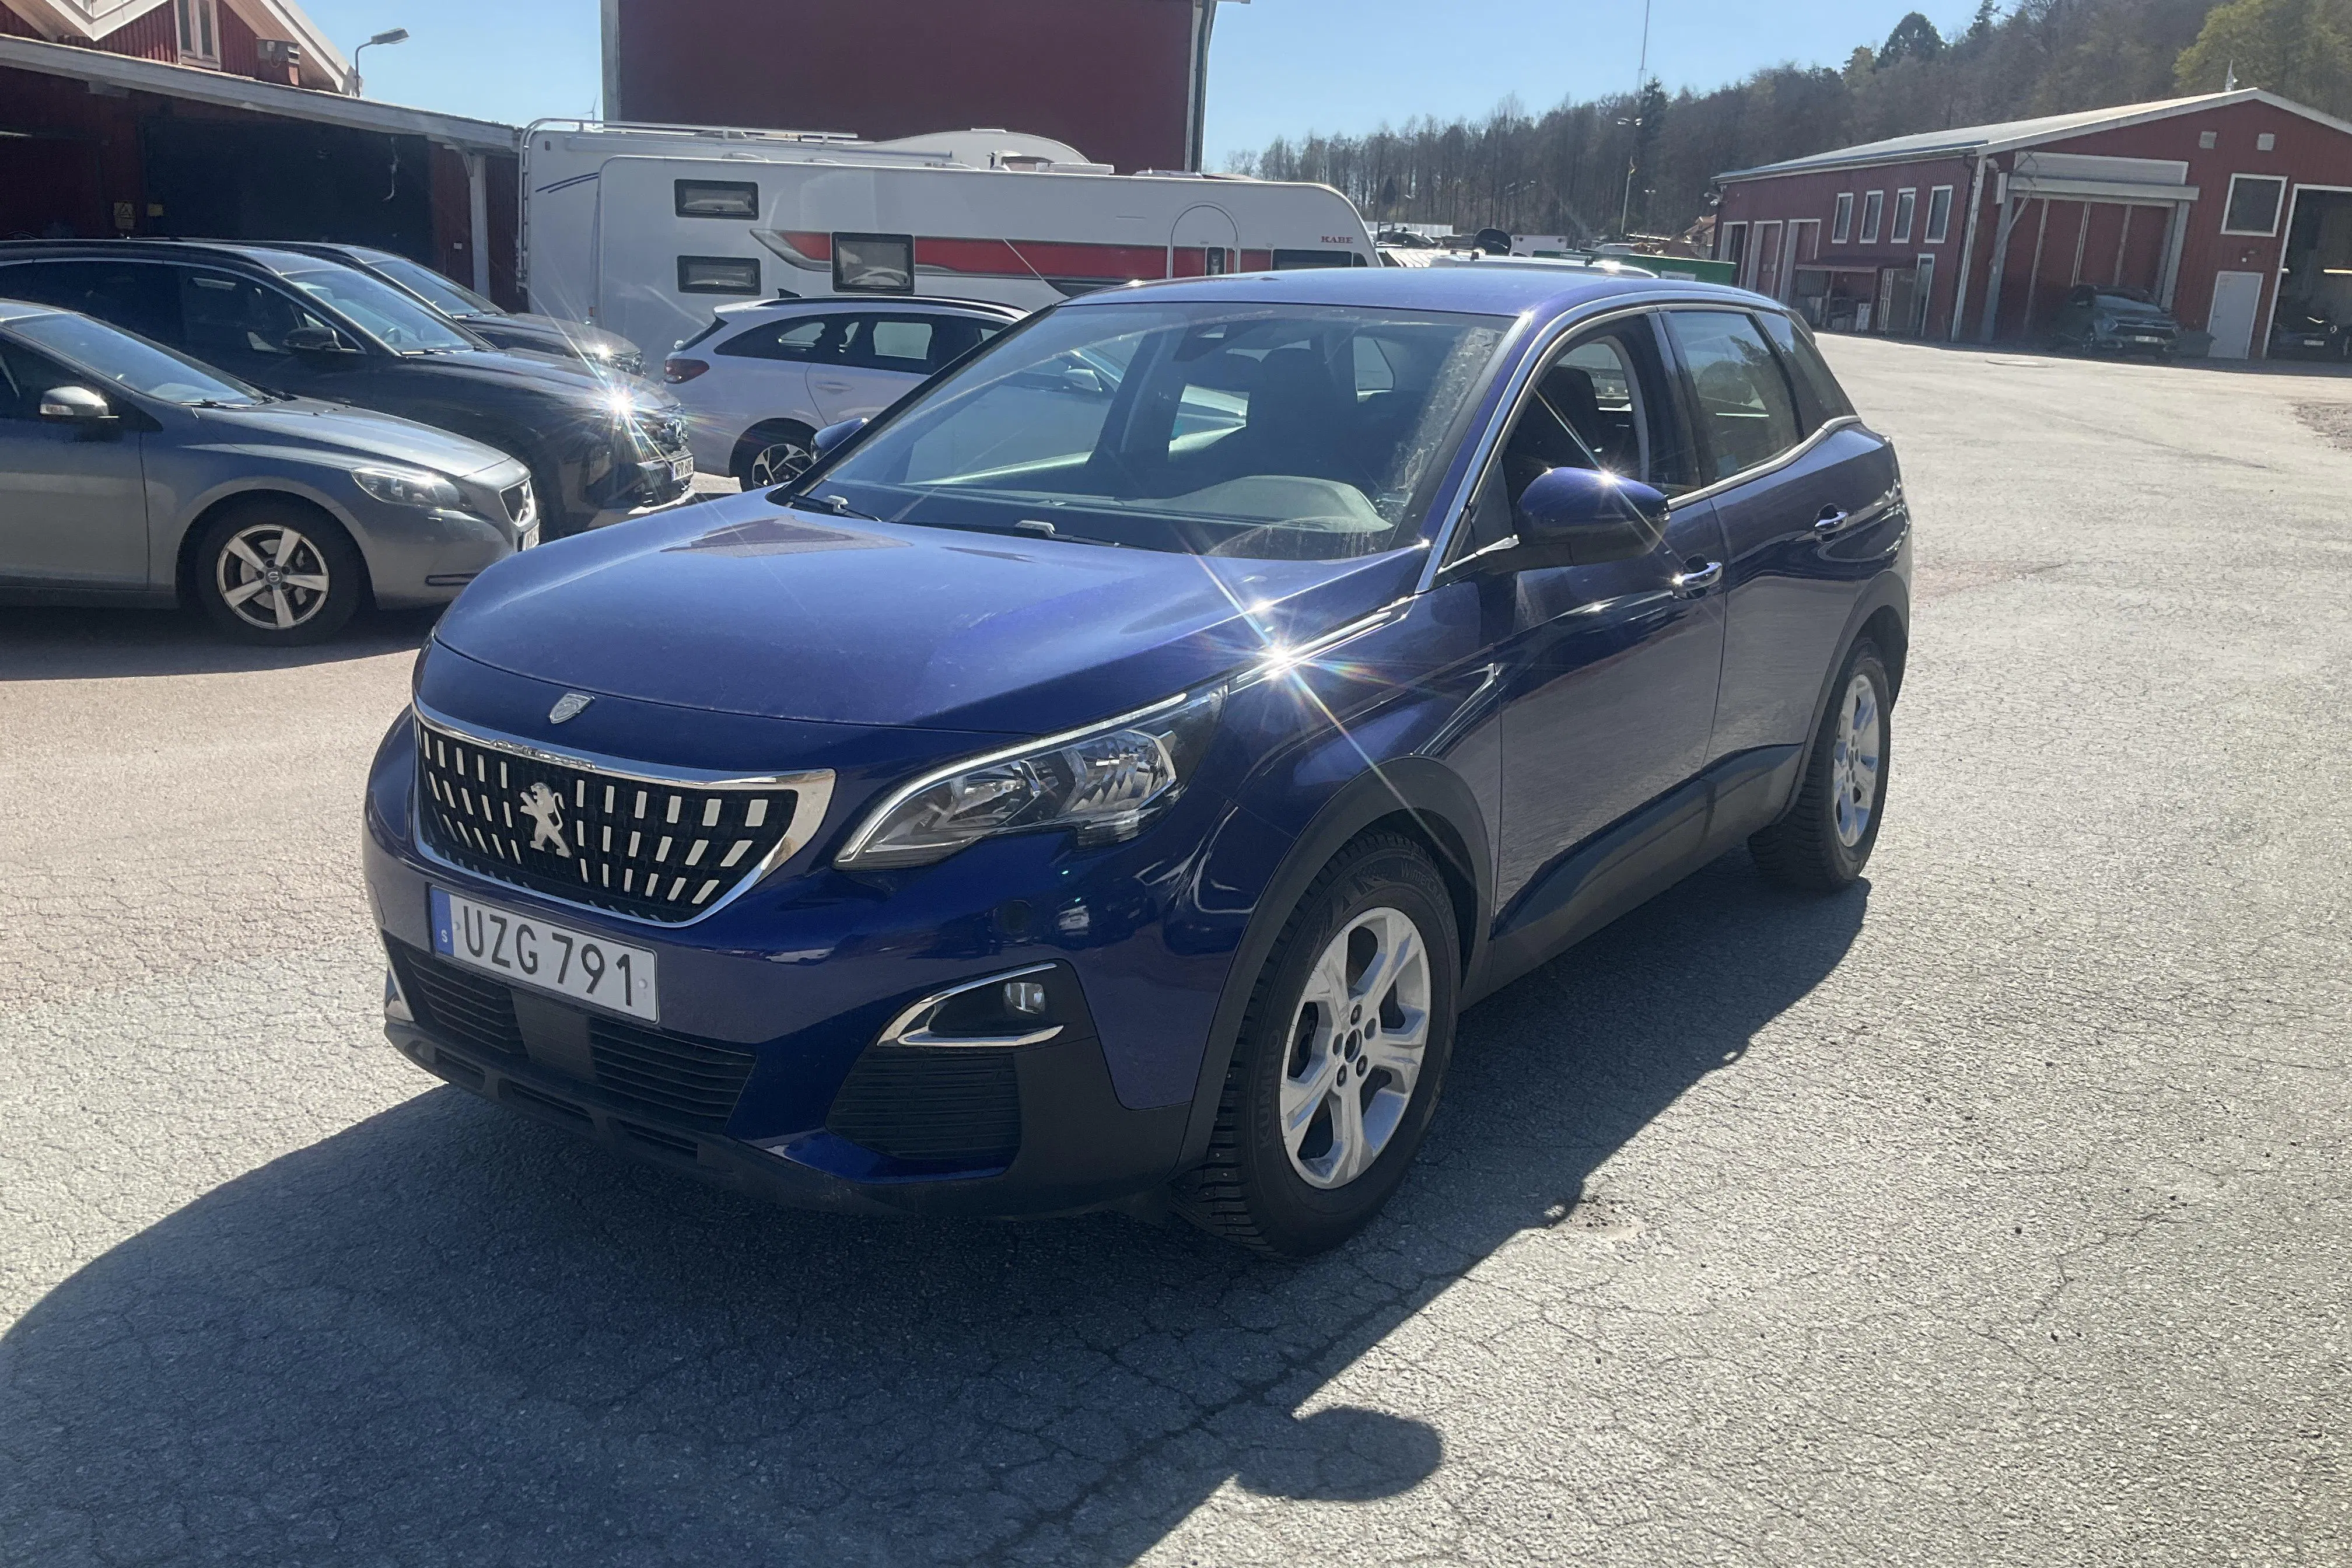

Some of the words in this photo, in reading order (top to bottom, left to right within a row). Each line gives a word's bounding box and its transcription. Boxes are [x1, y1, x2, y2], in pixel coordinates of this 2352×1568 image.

[441, 929, 448, 943] S
[464, 905, 538, 975] UZG
[552, 932, 633, 1006] 791
